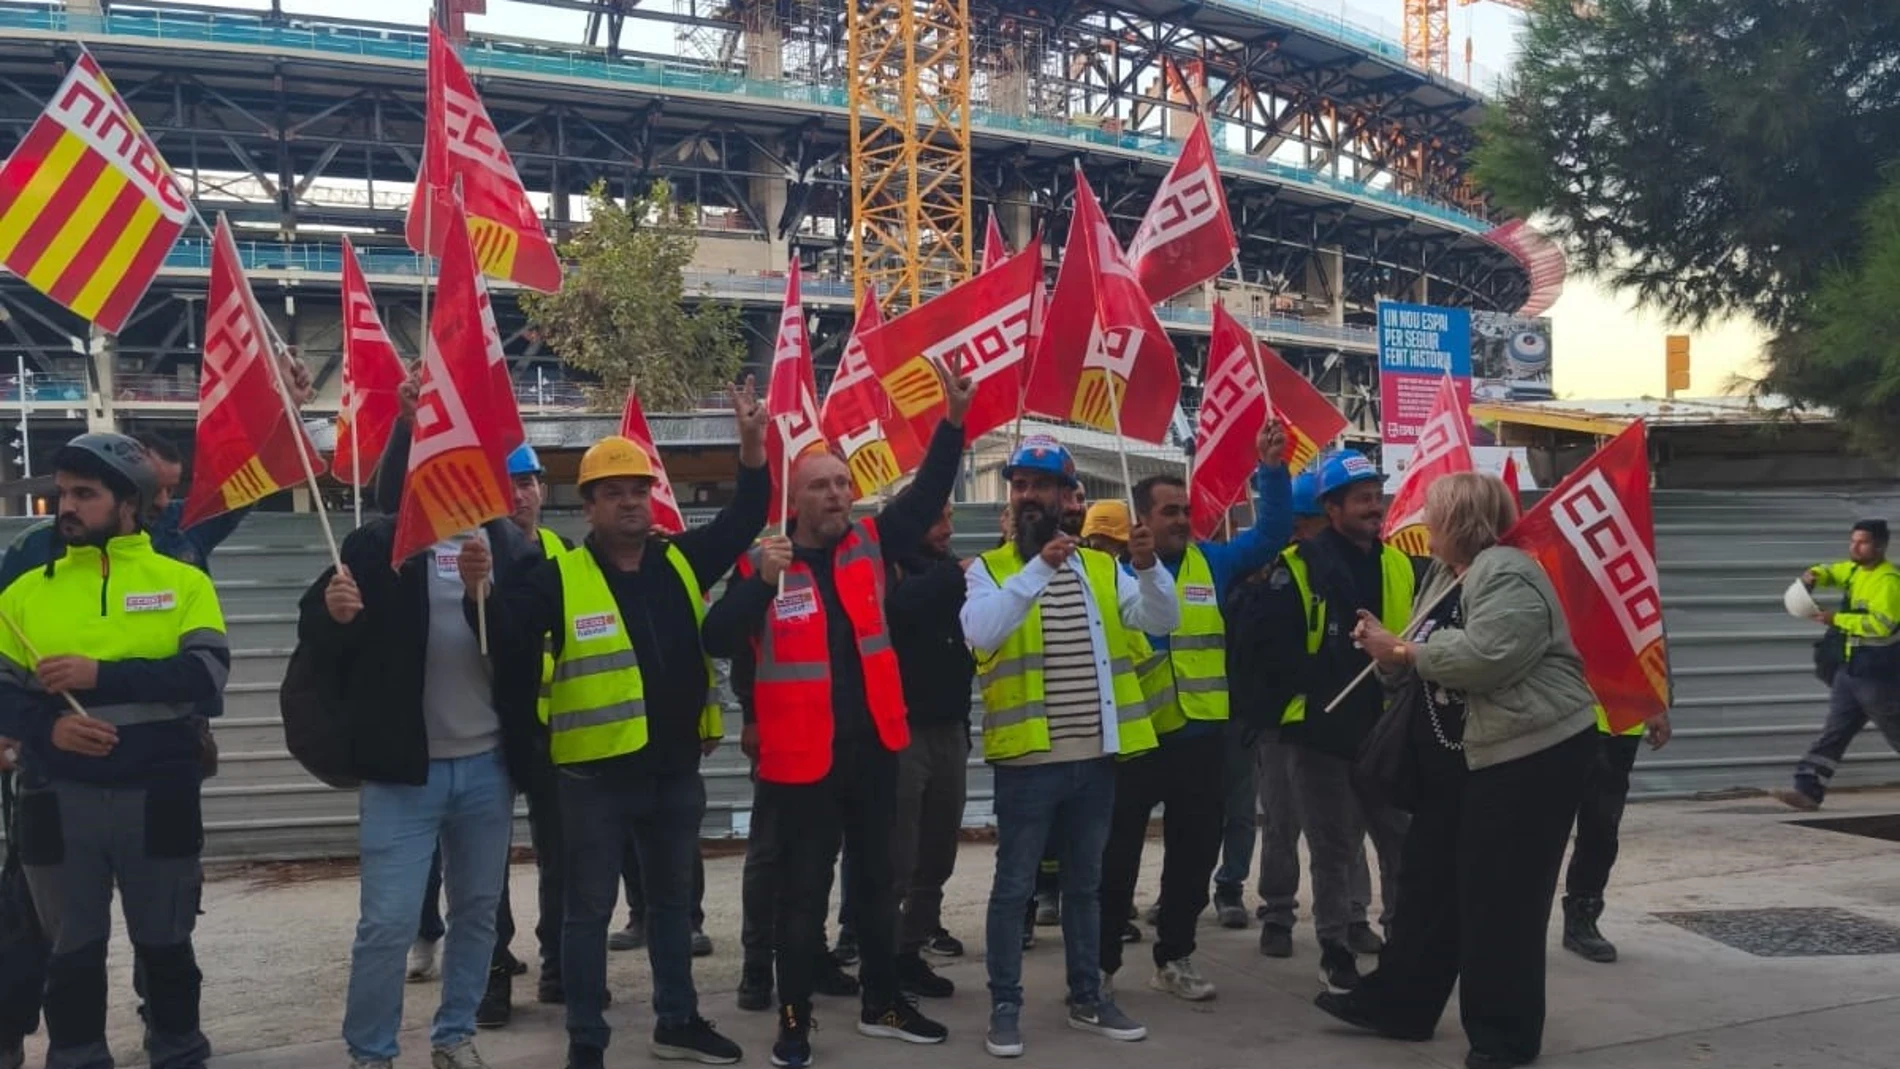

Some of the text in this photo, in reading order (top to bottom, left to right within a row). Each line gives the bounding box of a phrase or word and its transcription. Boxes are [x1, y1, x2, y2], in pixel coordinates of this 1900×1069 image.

[1384, 309, 1448, 332] UN NOU ESPAI
[1385, 329, 1439, 350] PER SEGUIR
[1385, 347, 1408, 367] FENT
[1562, 484, 1661, 632] CCOO
